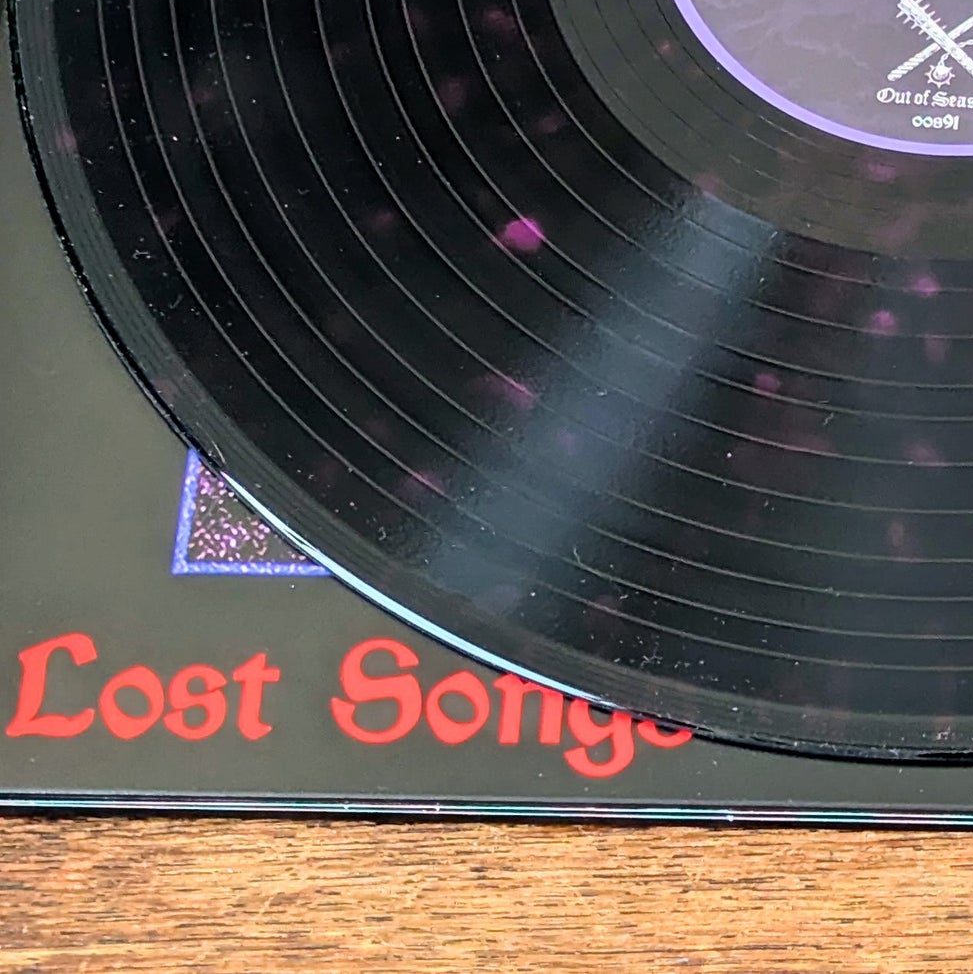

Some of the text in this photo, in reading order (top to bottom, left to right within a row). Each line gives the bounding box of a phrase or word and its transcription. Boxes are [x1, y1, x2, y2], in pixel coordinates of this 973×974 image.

[876, 87, 912, 105] Out
[913, 89, 932, 107] of
[5, 631, 282, 742] Lost
